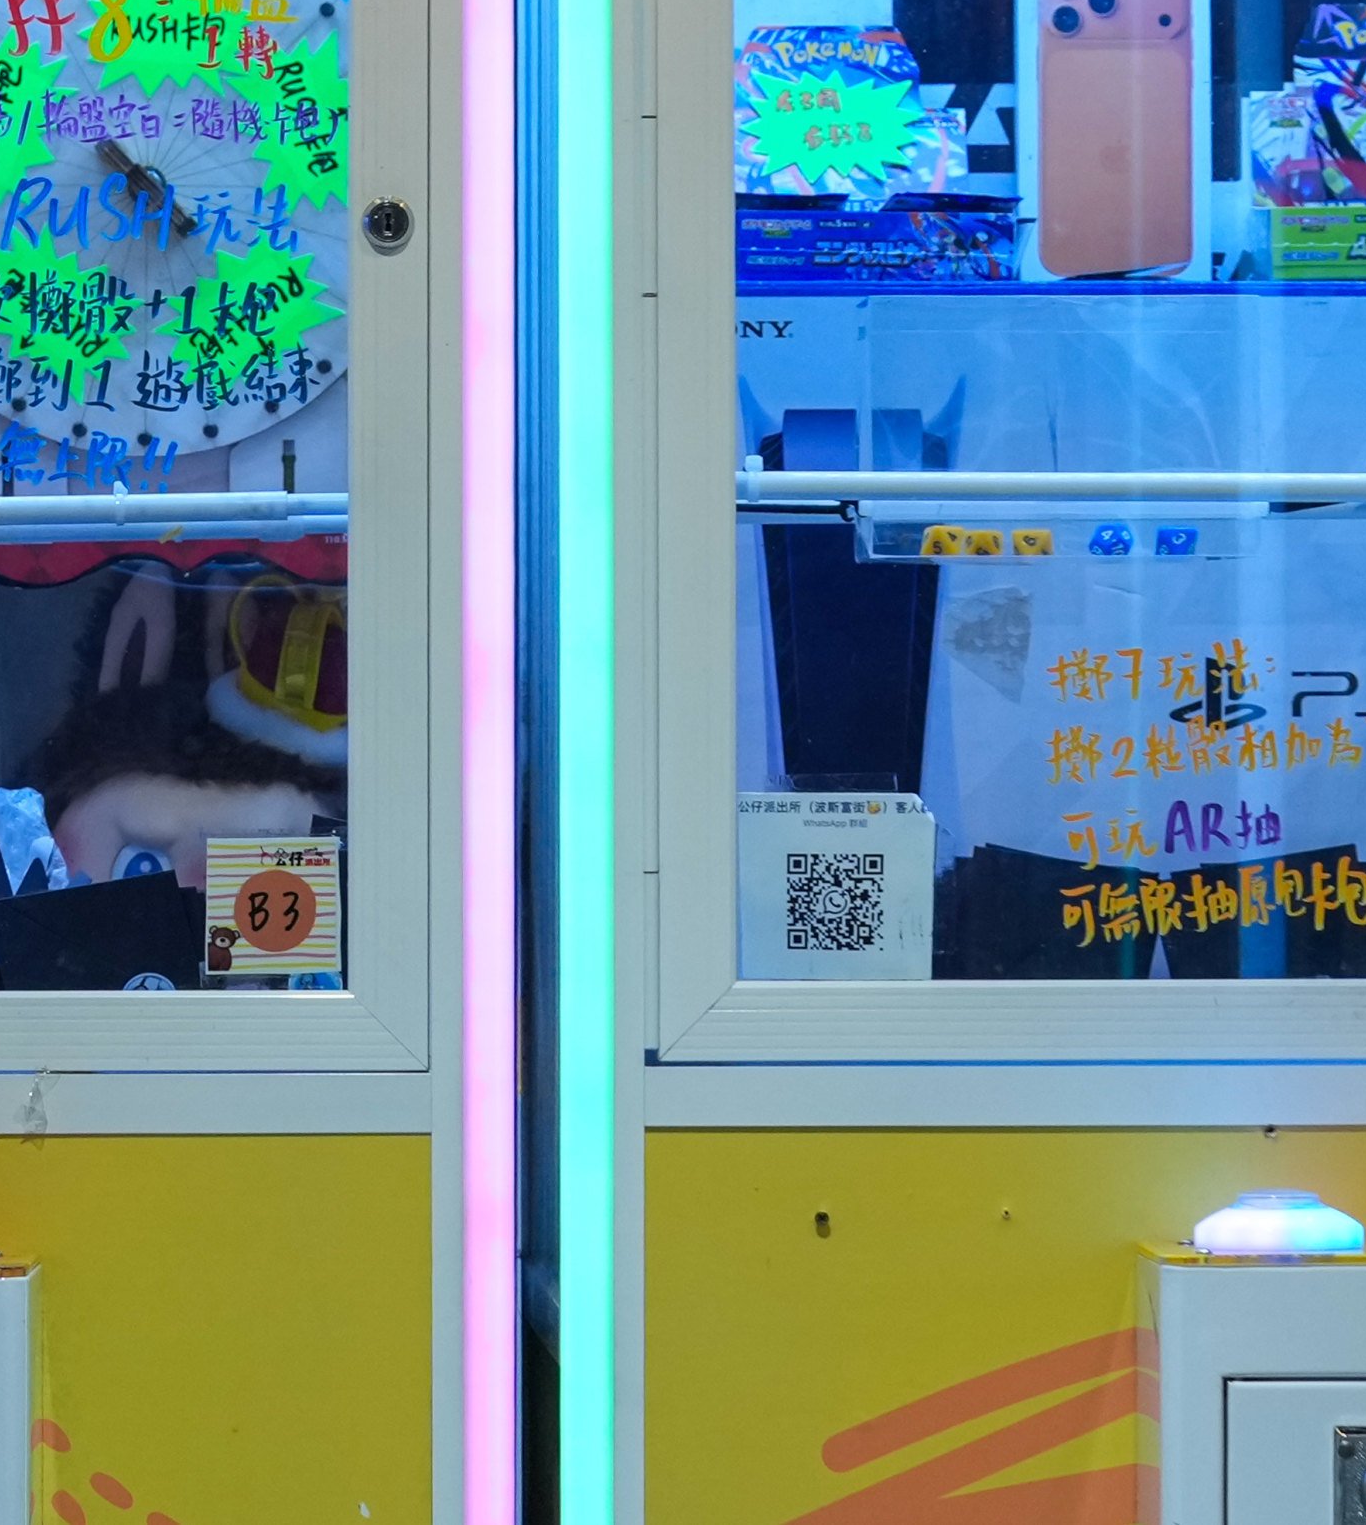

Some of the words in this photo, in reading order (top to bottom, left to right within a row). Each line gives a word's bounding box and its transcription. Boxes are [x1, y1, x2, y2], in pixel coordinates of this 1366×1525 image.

[0, 173, 176, 252] RUSH
[190, 183, 298, 255] 玩法
[248, 891, 300, 932] B3
